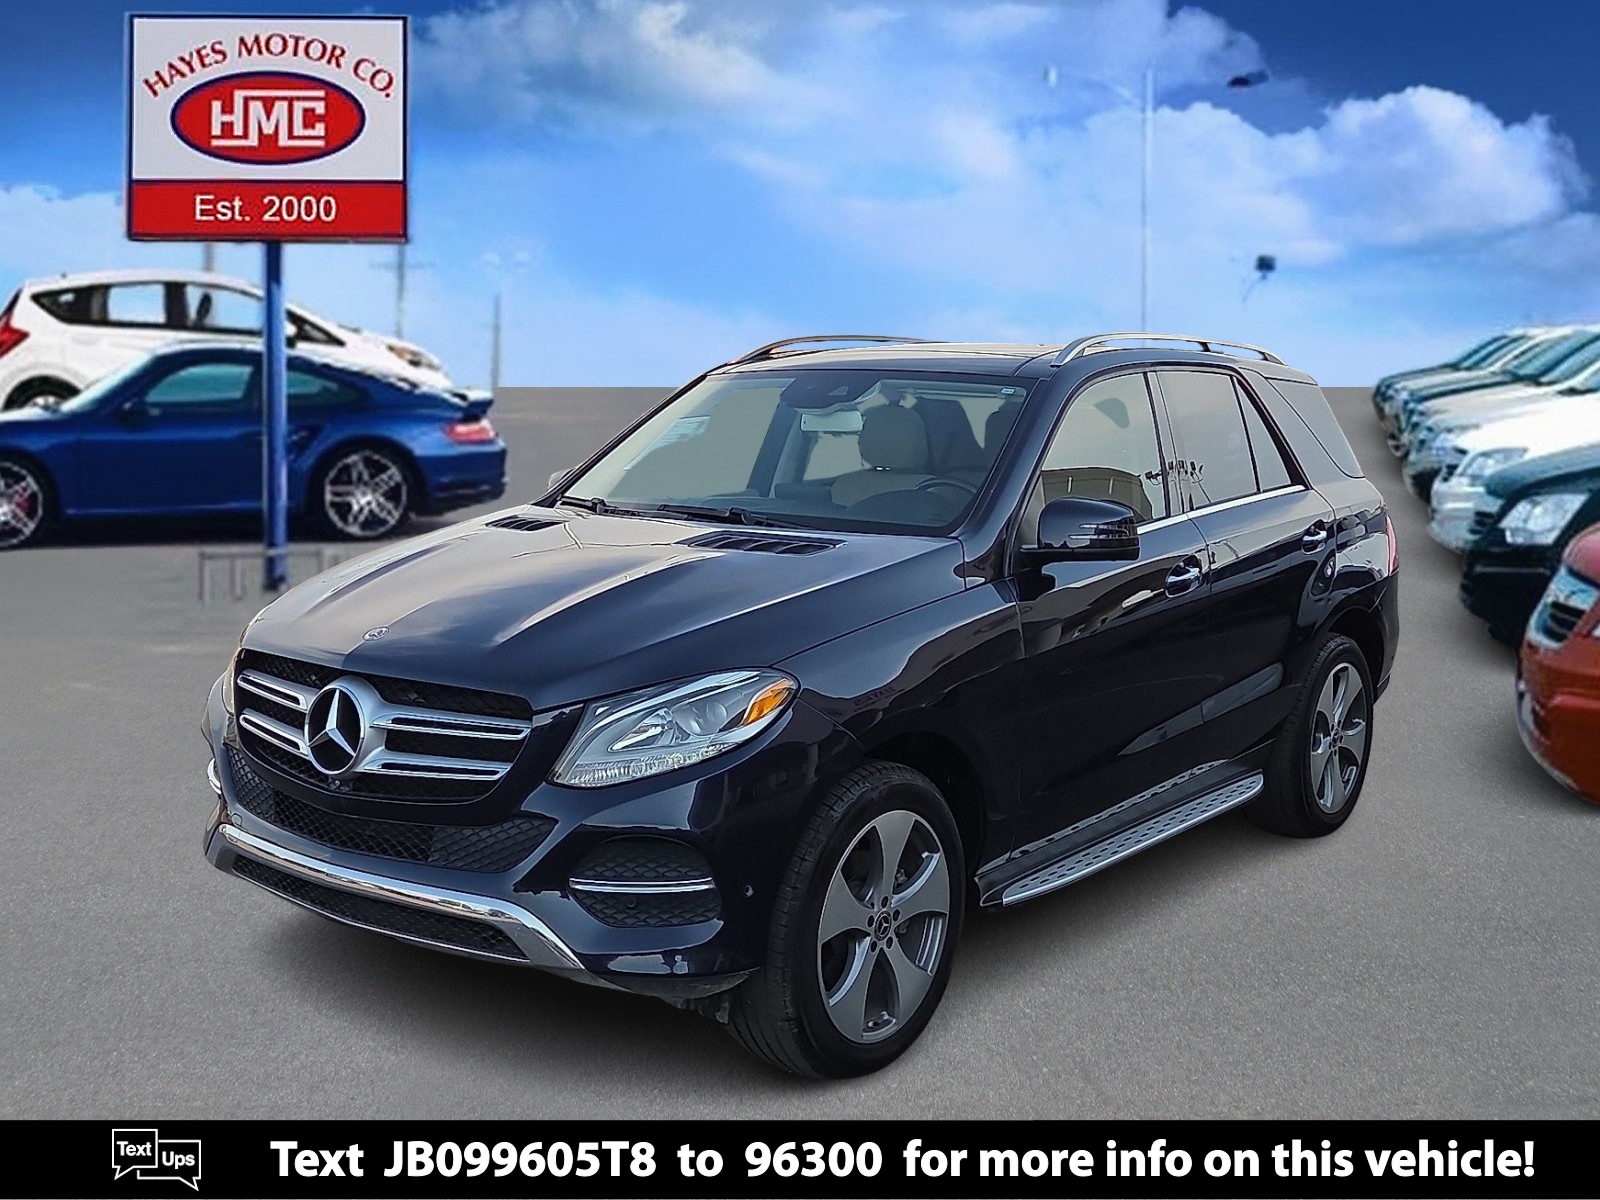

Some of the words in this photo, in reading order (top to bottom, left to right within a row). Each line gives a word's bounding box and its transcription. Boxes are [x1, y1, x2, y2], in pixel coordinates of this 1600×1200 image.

[142, 40, 228, 98] HAYES
[237, 32, 347, 70] MOTOR
[352, 57, 395, 98] CO.
[210, 89, 326, 147] HMC
[195, 194, 250, 222] Est.
[262, 194, 337, 222] 2000
